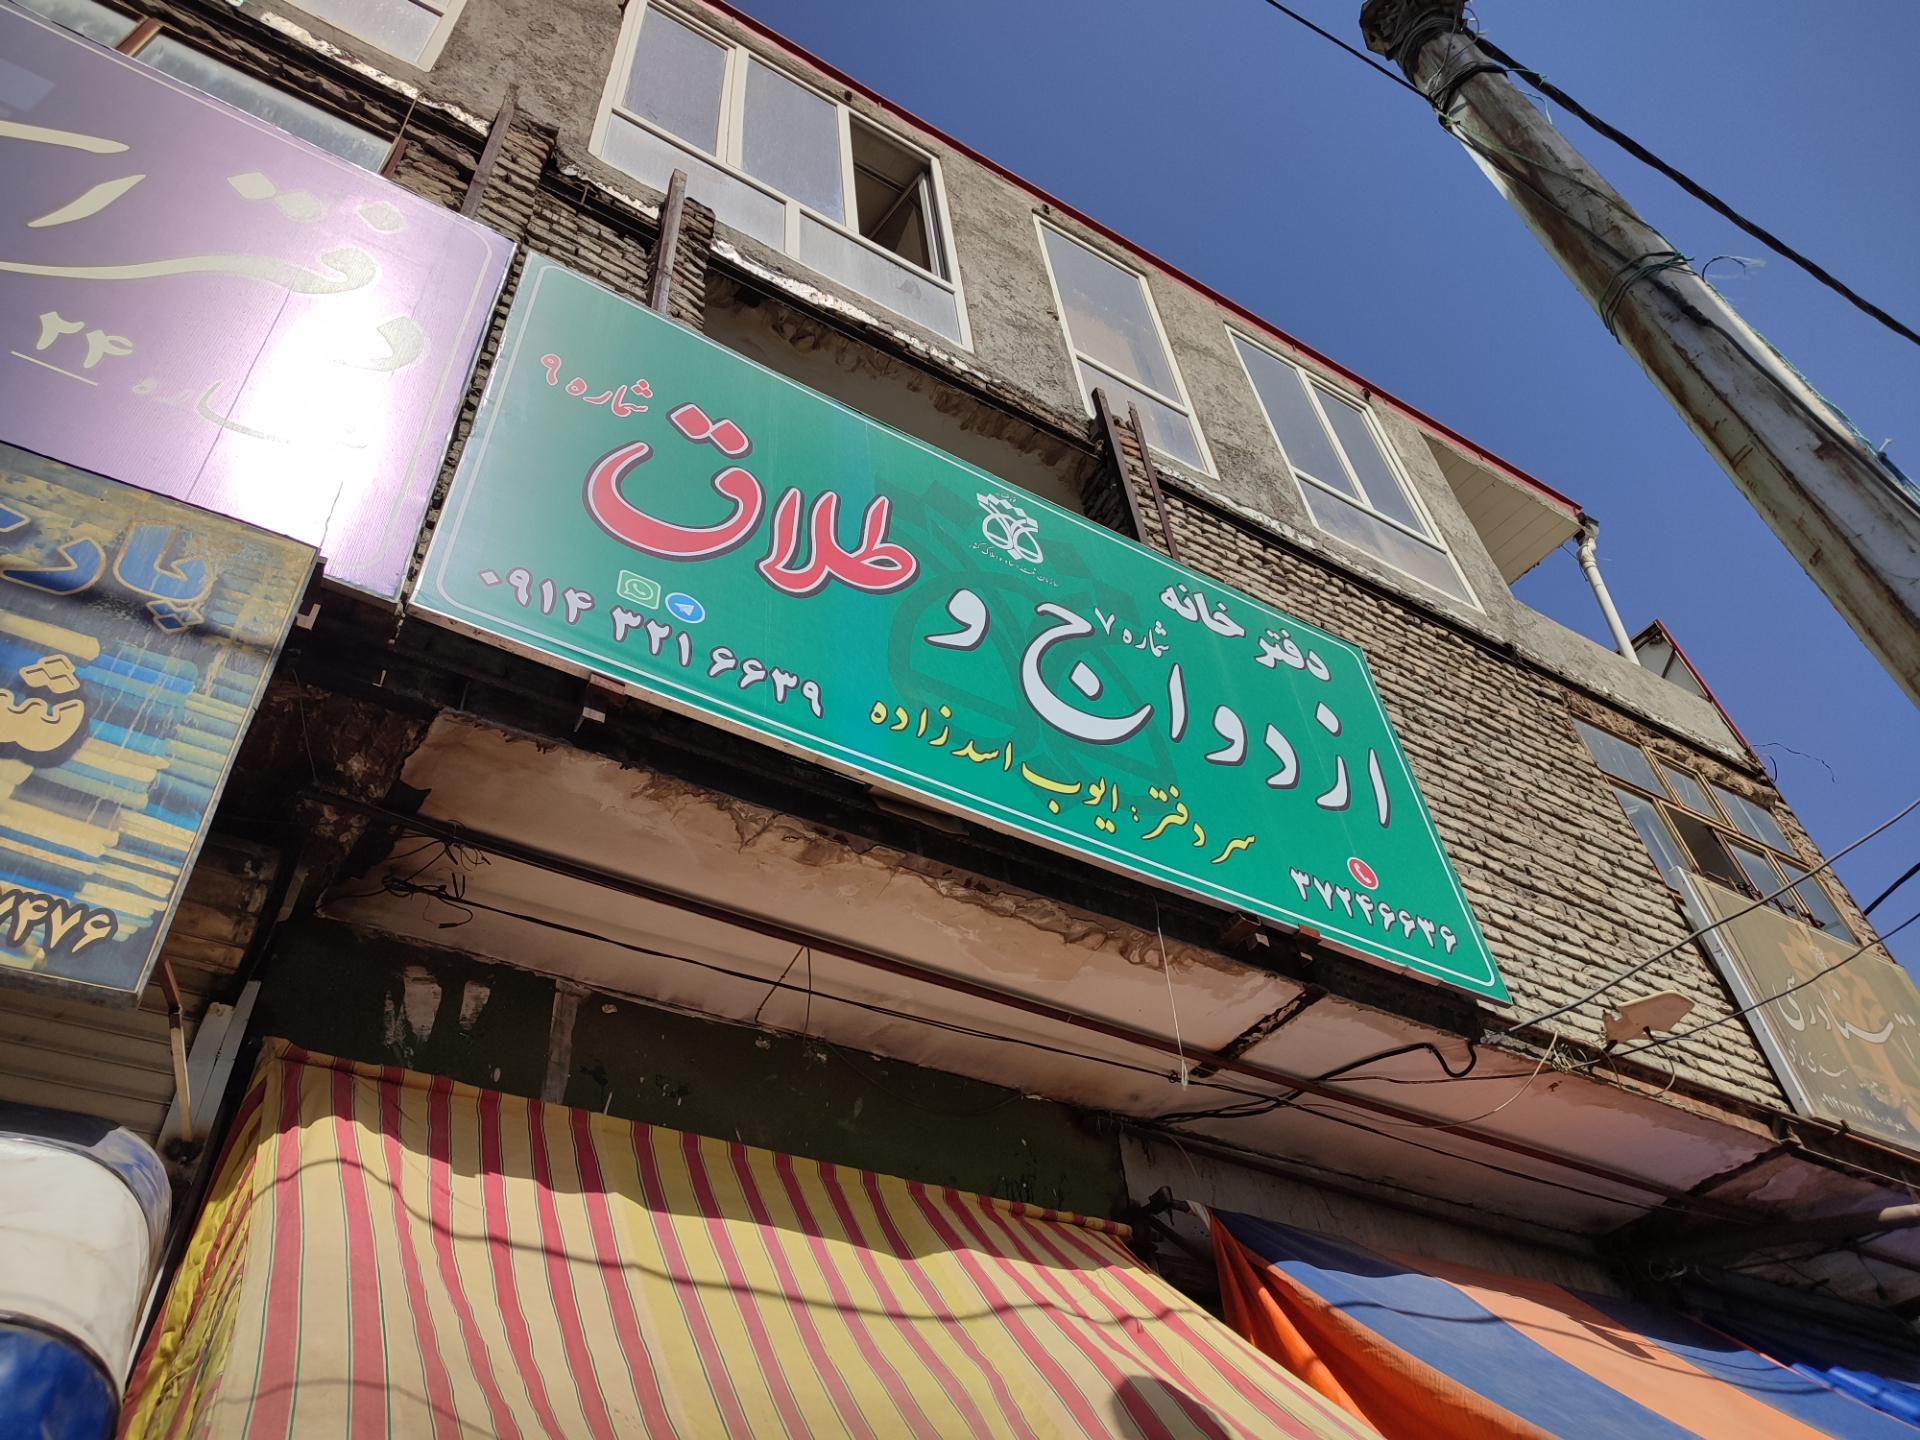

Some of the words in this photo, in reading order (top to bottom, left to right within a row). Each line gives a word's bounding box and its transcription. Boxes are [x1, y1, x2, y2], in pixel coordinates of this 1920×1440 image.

[540, 353, 562, 386] ۹
[565, 377, 655, 418] شماره
[581, 401, 920, 599] طلاق
[924, 587, 991, 652] و
[1093, 606, 1116, 637] ۷
[1121, 620, 1171, 659] شماره
[1159, 582, 1248, 639] خانه
[479, 568, 595, 625] ۰۹۱۴
[610, 605, 693, 668] ۳۲۱
[708, 647, 824, 719] ۶۶۳۹
[1254, 627, 1332, 683] دفتر
[1018, 600, 1391, 829] ازدواج
[1020, 761, 1119, 834] ایوب
[1289, 866, 1458, 955] ۳۷۲۴۶۶۳۶
